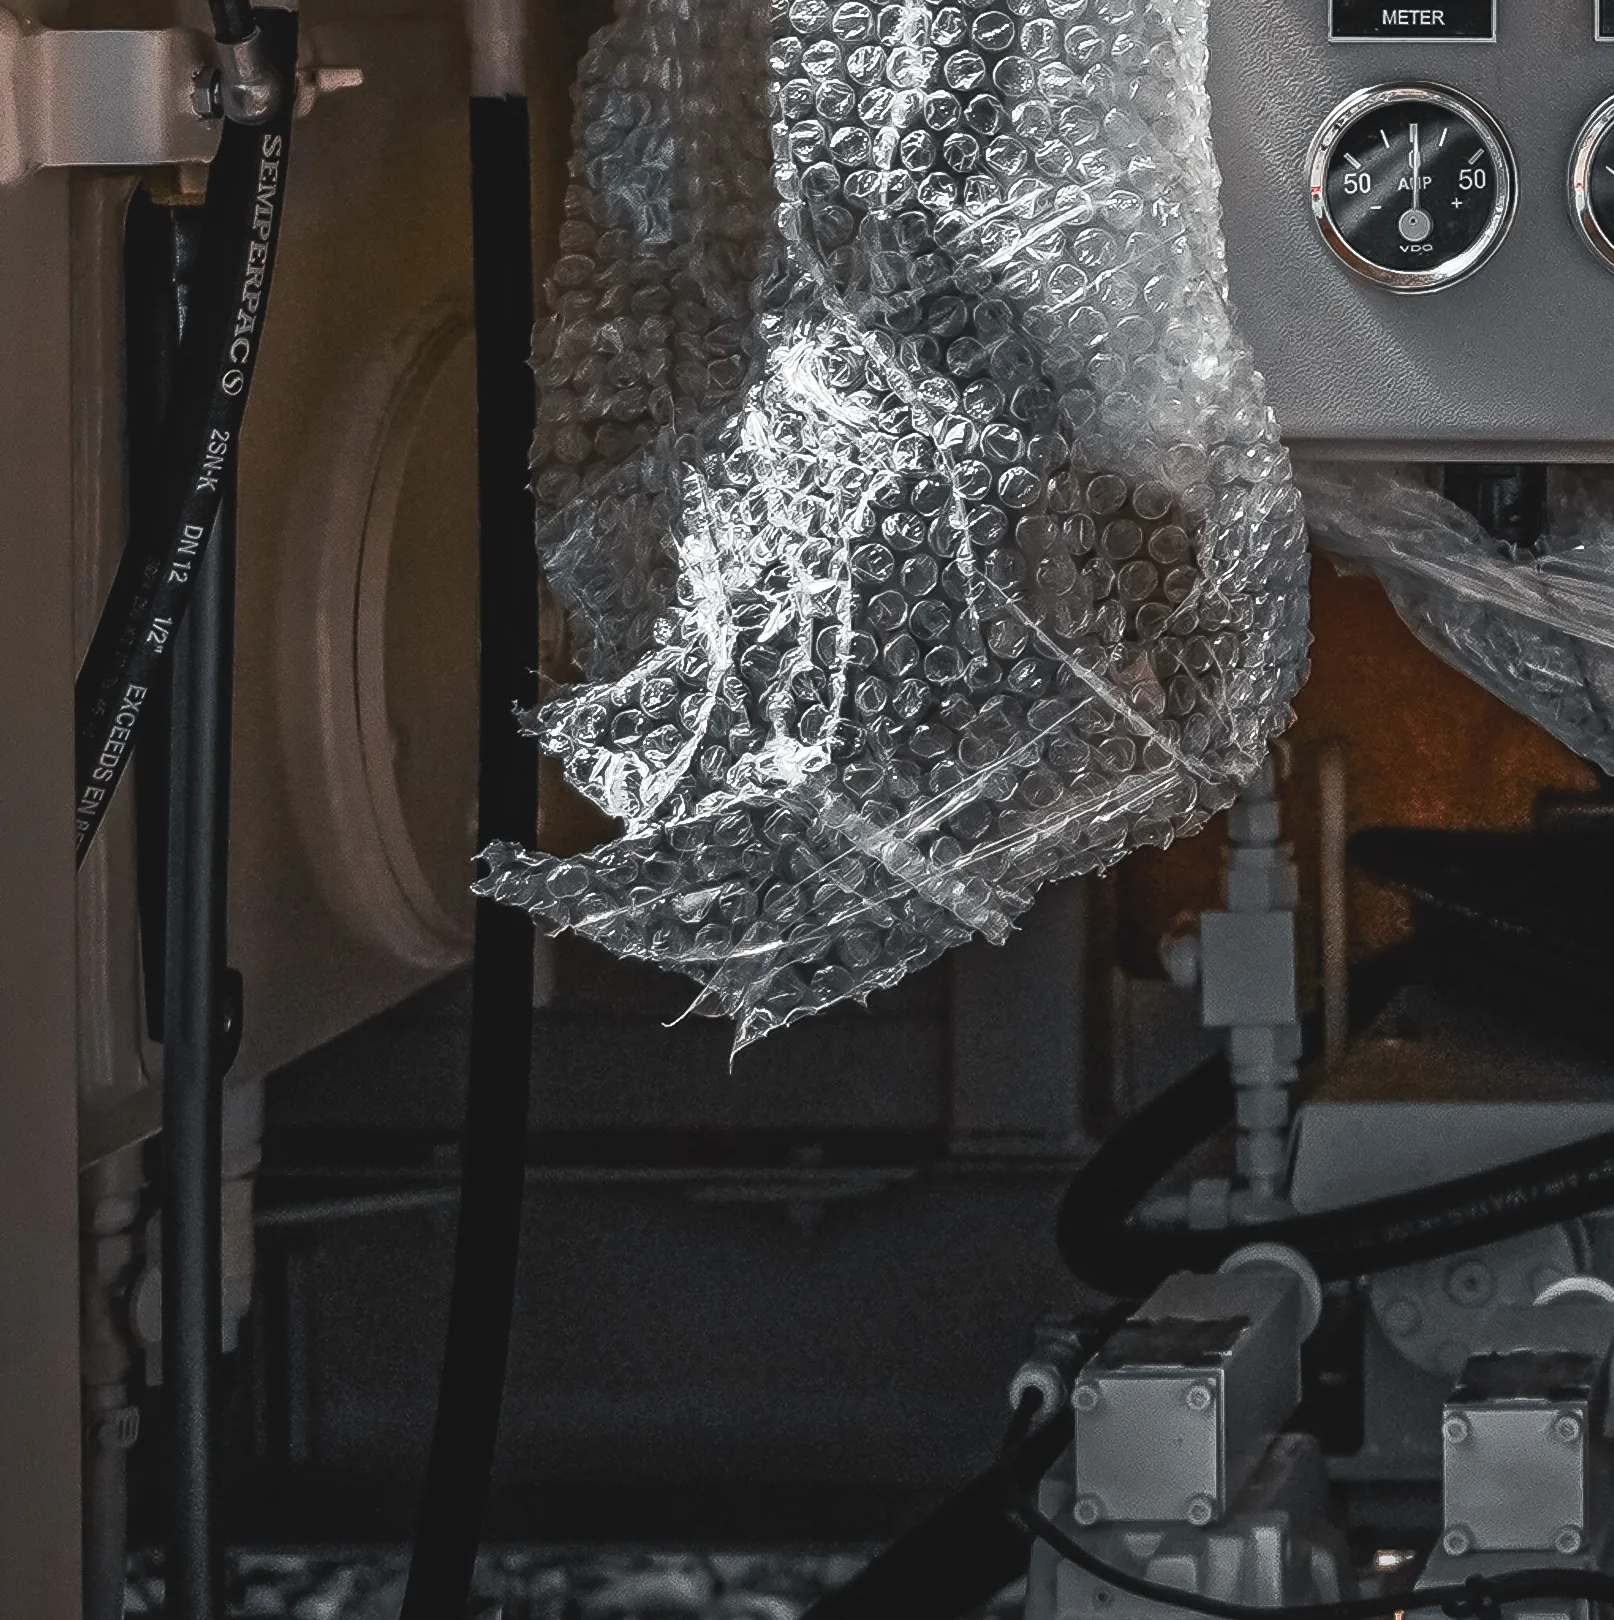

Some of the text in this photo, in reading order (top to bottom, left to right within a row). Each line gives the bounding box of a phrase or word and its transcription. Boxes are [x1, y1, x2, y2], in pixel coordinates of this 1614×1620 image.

[1382, 9, 1445, 26] METER
[1344, 173, 1371, 194] 50
[1458, 169, 1486, 190] 50
[229, 134, 282, 365] SEMPERPAC
[1400, 245, 1433, 253] VDO
[196, 430, 230, 491] 2SN-K
[180, 524, 204, 562] DN
[167, 559, 189, 584] 12
[92, 683, 147, 782] EXCEEDS
[81, 786, 107, 816] EN
